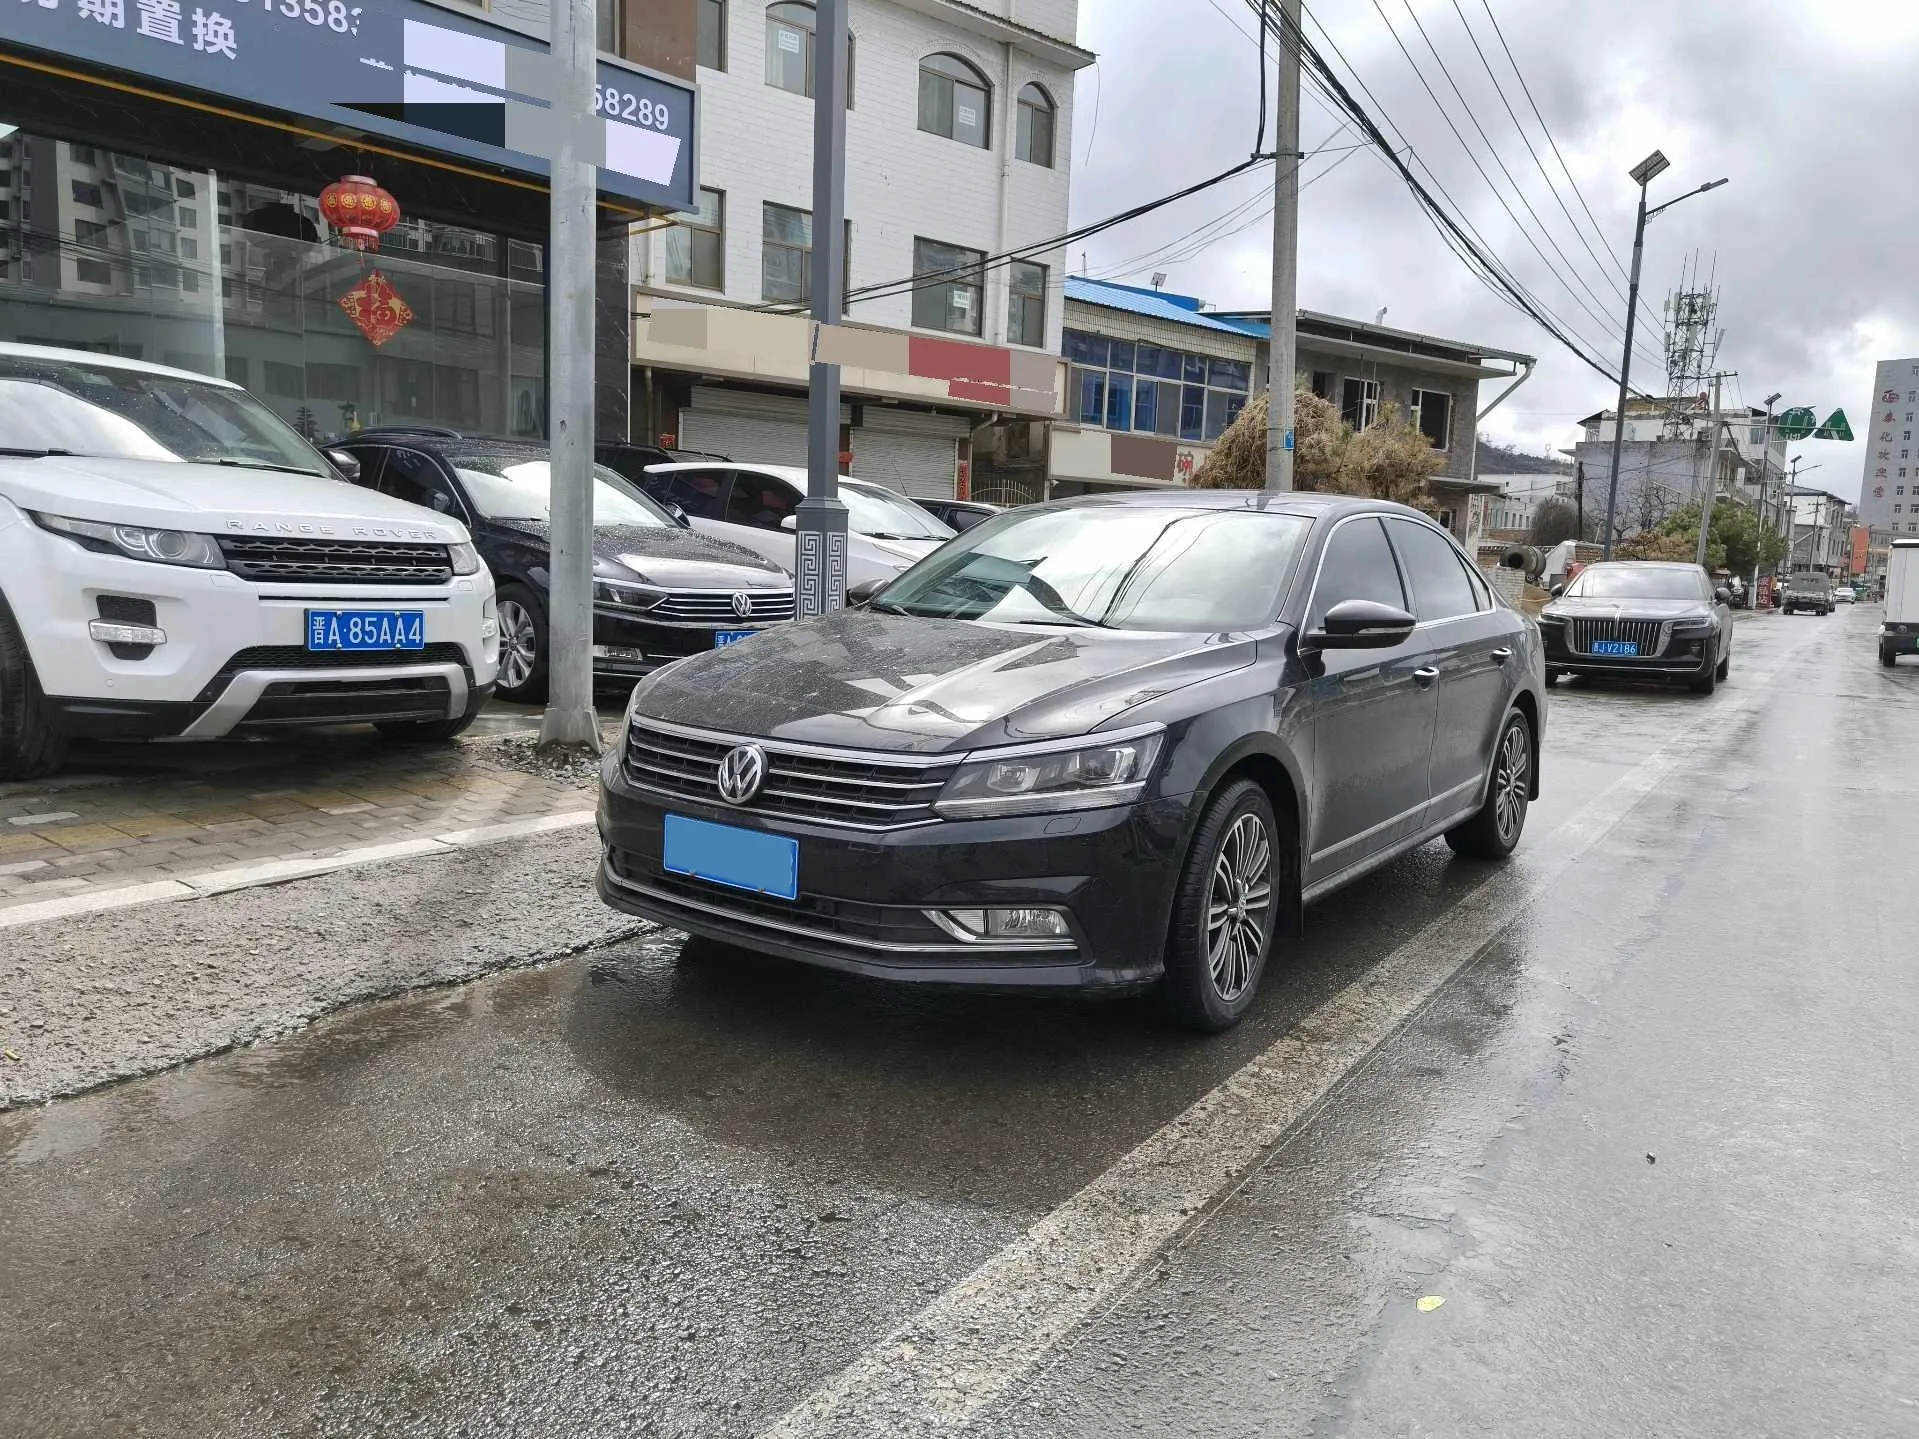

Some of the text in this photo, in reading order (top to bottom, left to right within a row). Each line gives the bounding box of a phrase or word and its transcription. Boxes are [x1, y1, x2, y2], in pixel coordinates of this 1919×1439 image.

[20, 0, 238, 60] 期置换
[225, 519, 438, 540] RANGE ROVER
